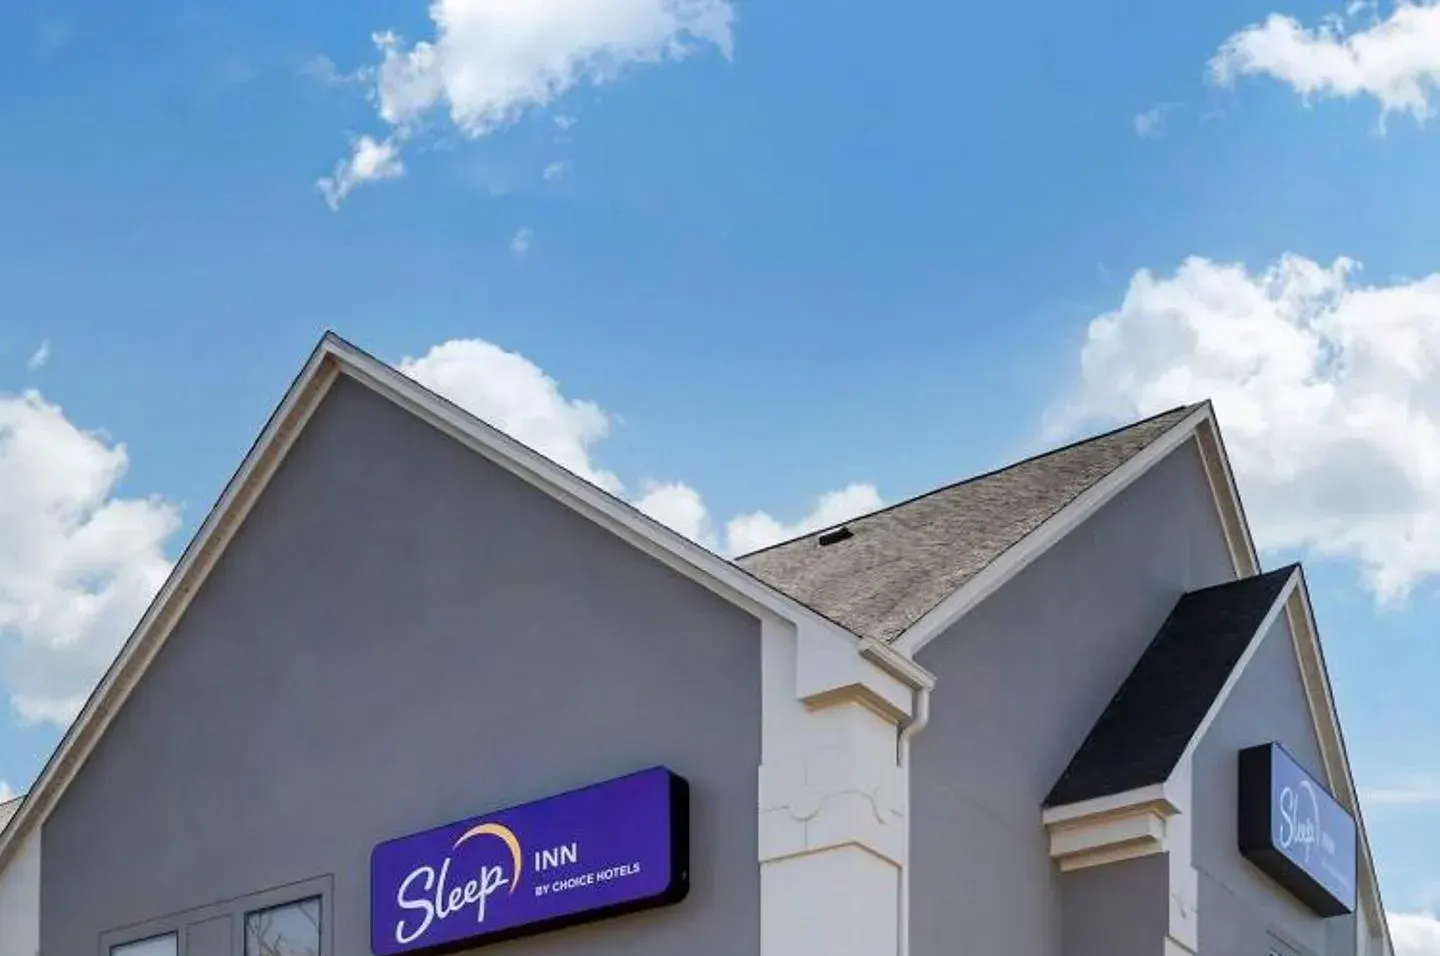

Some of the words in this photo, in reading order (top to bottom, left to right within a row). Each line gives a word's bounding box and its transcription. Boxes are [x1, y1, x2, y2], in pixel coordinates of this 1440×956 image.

[1280, 786, 1315, 864] Sleep
[396, 857, 509, 944] Sleep
[535, 842, 577, 871] INN
[535, 884, 550, 896] BY
[552, 873, 594, 892] CHOICE
[596, 861, 641, 881] HOTELS
